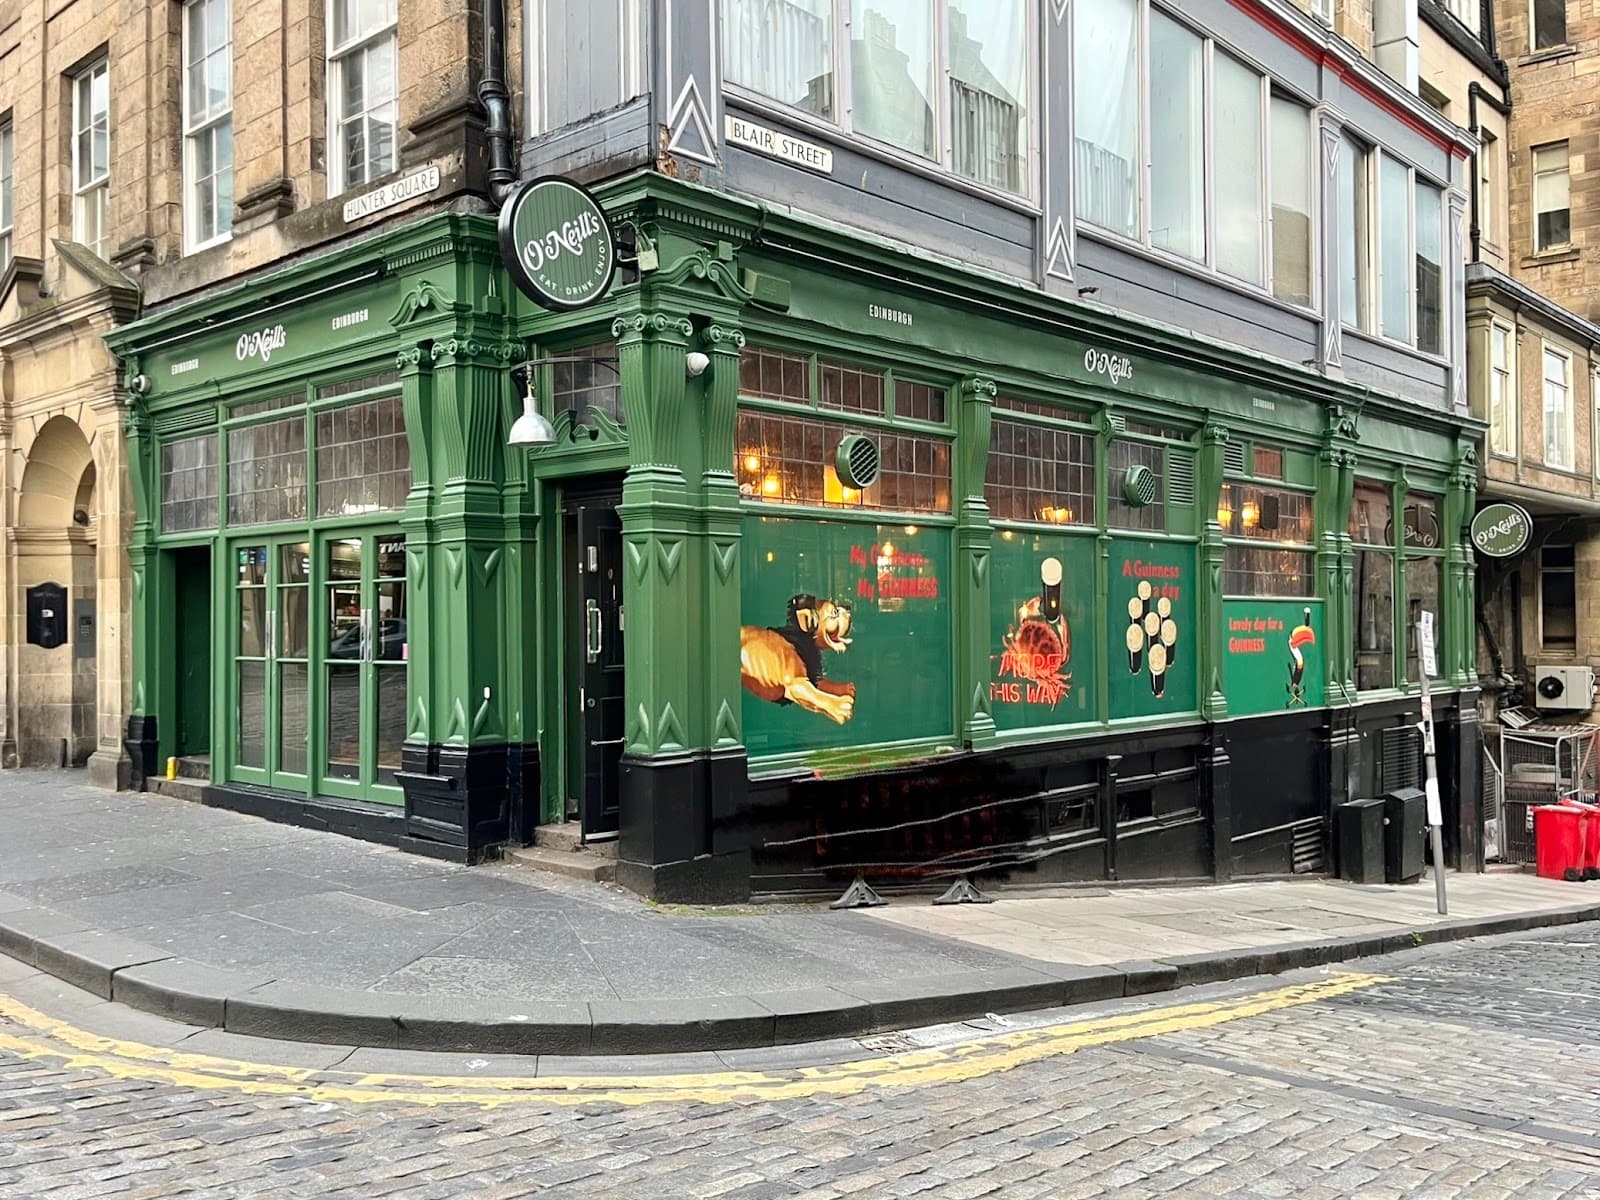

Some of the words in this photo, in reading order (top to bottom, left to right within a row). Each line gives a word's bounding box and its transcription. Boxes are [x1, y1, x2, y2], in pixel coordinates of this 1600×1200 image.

[734, 122, 774, 150] BLAIR
[782, 139, 827, 167] STREET
[346, 190, 387, 220] HUNTER
[391, 168, 436, 201] SQUARE
[523, 210, 600, 271] O'Neill's
[539, 273, 557, 291] EAT
[565, 279, 595, 296] DRINK
[594, 238, 606, 276] ENJOY
[332, 308, 369, 331] EDINBURGH
[869, 304, 913, 326] EDINBURGH
[236, 323, 287, 362] O'Neill's
[1084, 348, 1133, 385] O'Neill's
[1476, 514, 1521, 545] O'Neill's
[851, 545, 867, 570] My
[1123, 560, 1131, 576] A
[1133, 559, 1180, 579] Guinness
[858, 578, 875, 603] My
[1153, 586, 1160, 598] a
[1254, 616, 1266, 633] day
[1229, 637, 1265, 653] GUINNESS
[998, 652, 1061, 678] MORE
[1026, 683, 1060, 705] WAY
